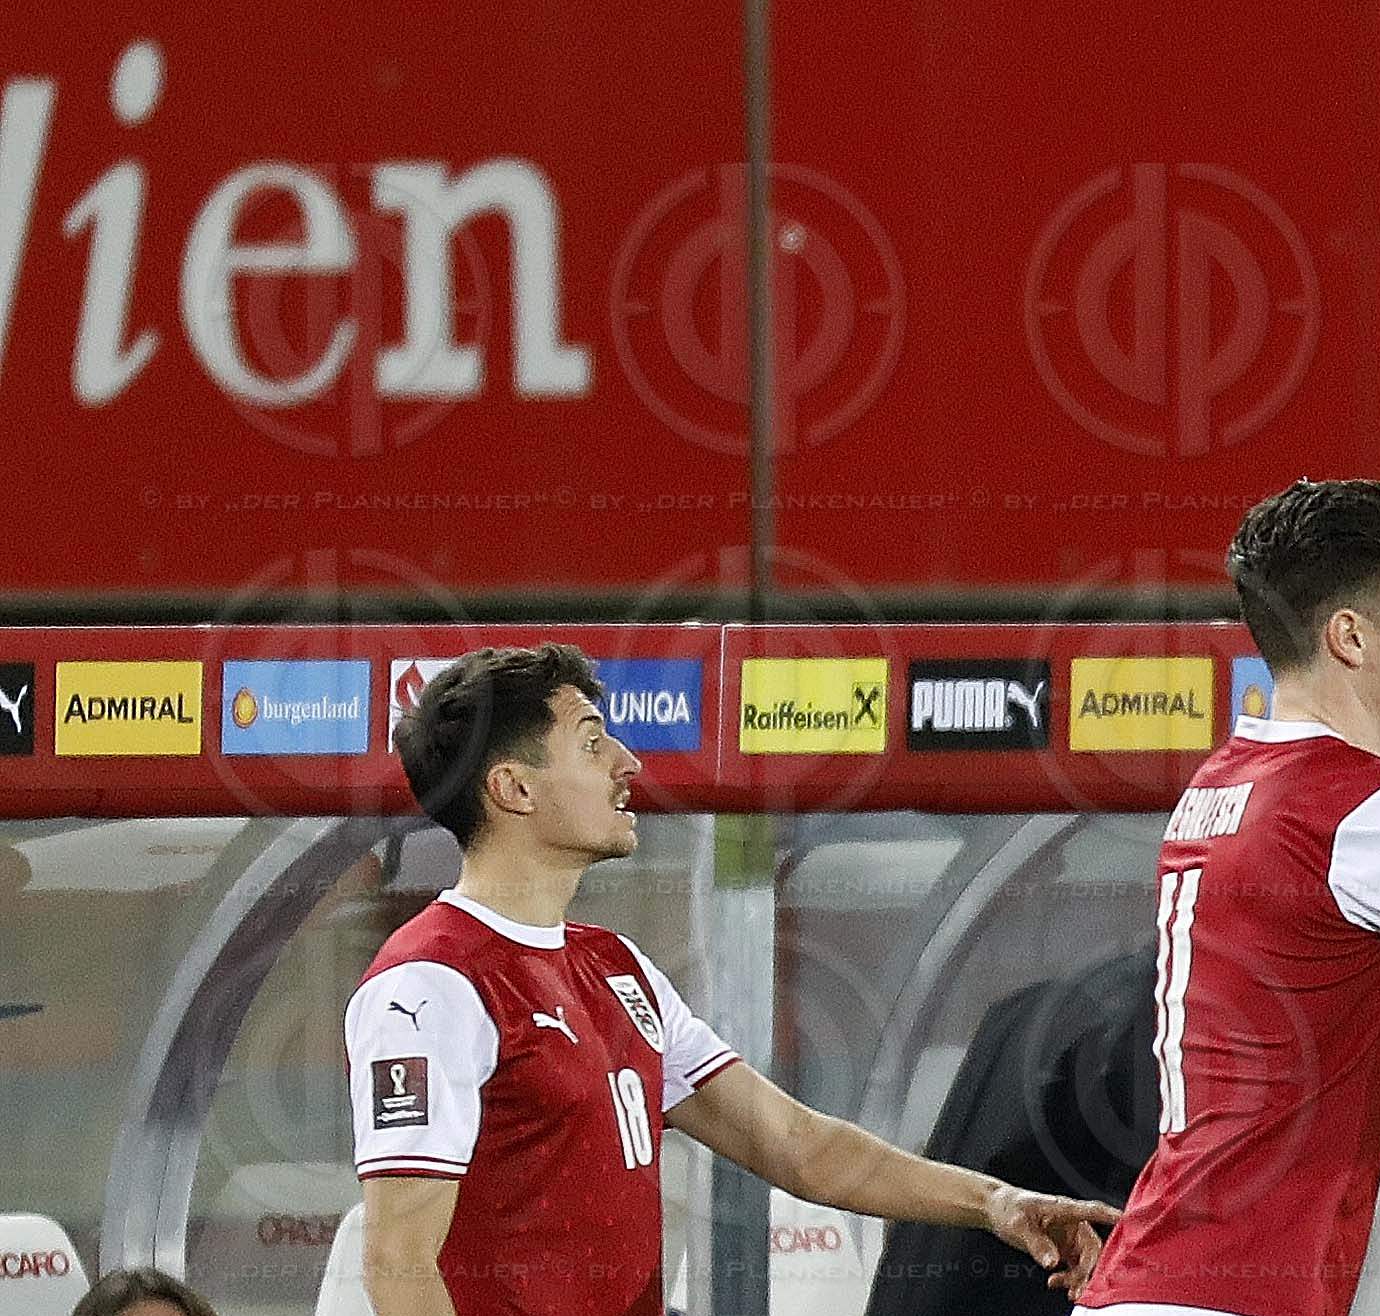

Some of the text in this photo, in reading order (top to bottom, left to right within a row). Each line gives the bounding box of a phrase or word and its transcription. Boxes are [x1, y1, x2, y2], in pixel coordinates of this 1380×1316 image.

[0, 38, 594, 408] ien
[64, 692, 194, 725] ADMIRAL
[263, 695, 360, 726] burgenland
[609, 690, 690, 725] UNIQA
[743, 703, 849, 731] Raiffeisen
[912, 680, 1005, 730] PUMA
[1078, 689, 1205, 719] ADMIRAL
[607, 1068, 653, 1170] 18
